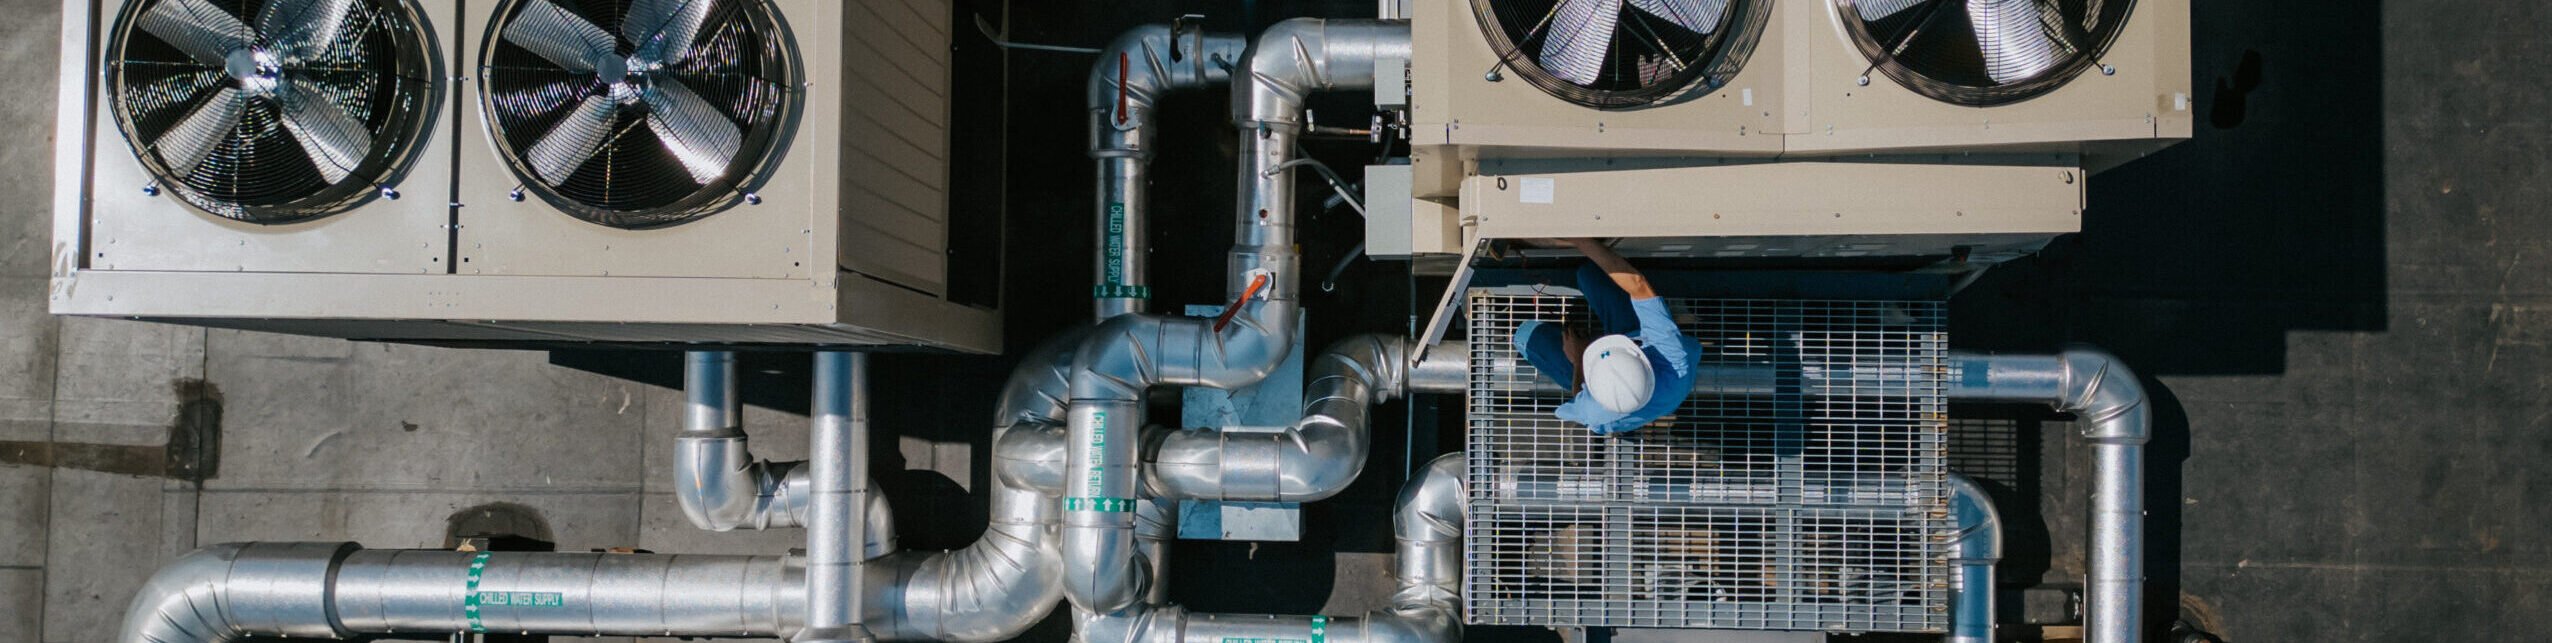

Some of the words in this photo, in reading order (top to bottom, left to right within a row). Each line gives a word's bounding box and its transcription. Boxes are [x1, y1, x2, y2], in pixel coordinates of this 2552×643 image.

[1110, 205, 1122, 233] CHILLED
[1109, 235, 1121, 257] WATER
[1108, 259, 1121, 282] SUPPLY
[1089, 415, 1104, 444] CHILLED
[480, 592, 508, 605] CHILLED
[511, 593, 532, 606] WATER
[534, 593, 560, 606] SUPPLY
